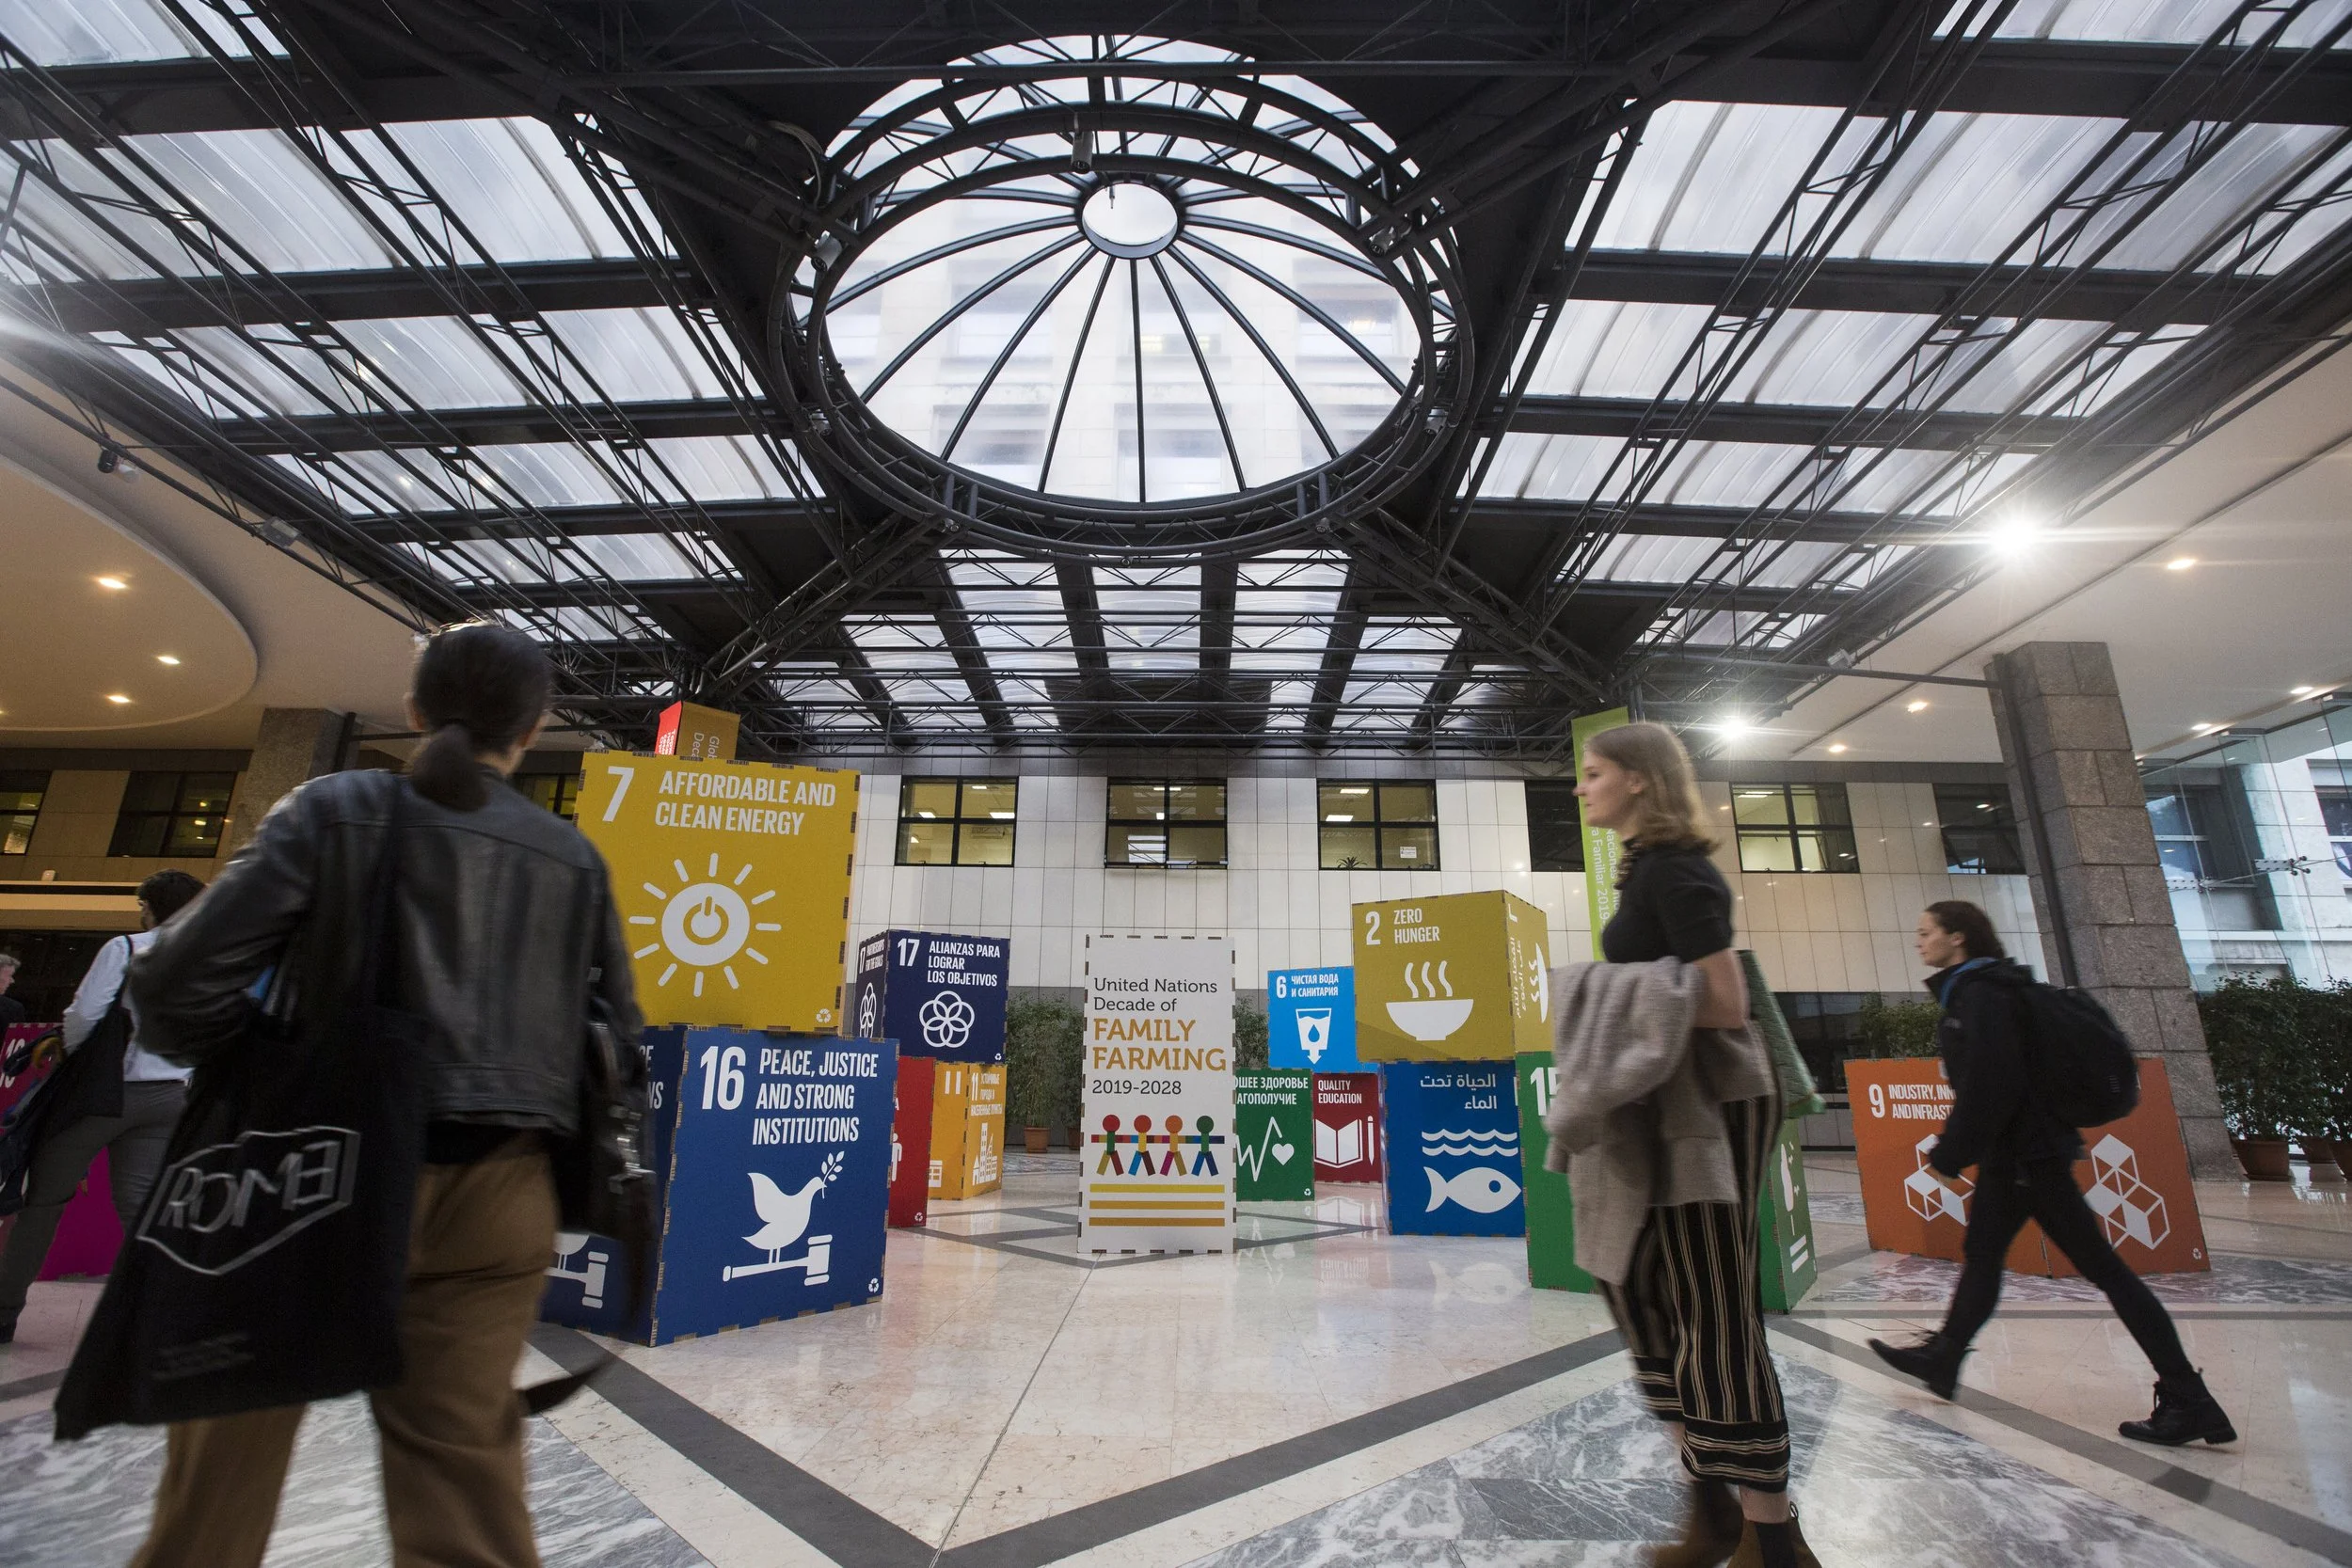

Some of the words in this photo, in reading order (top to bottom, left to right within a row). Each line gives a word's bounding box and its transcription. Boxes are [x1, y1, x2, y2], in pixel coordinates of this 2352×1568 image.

[602, 766, 634, 822] 7
[659, 770, 790, 804] AFFORDABLE
[793, 782, 836, 807] AND
[655, 801, 723, 830] CLEAN
[725, 807, 805, 835] ENERGY
[1592, 838, 1605, 885] Familiar
[1393, 908, 1422, 926] ZERO
[1597, 889, 1611, 929] 2019-
[1365, 911, 1381, 946] 2
[1394, 926, 1440, 944] HUNGER
[897, 938, 920, 967] 17
[929, 941, 975, 957] ALIANZAS
[976, 944, 1000, 958] PARA
[928, 956, 965, 970] LOGRAR
[927, 971, 946, 984] LOS
[947, 972, 997, 987] OBJETIVOS
[1093, 977, 1149, 992] United
[1154, 978, 1217, 993] Nations
[1276, 975, 1287, 998] 6
[1291, 975, 1317, 985] ЧИСТАЯ
[1319, 974, 1339, 985] ВОДА
[1291, 989, 1296, 997] И
[1298, 987, 1339, 997] САНИТАРИЯ
[1093, 996, 1155, 1011] Decade
[1160, 998, 1178, 1011] of
[1093, 1018, 1197, 1041] FAMILY
[759, 1048, 816, 1077] PEACE,
[818, 1051, 879, 1077] JUSTICE
[1092, 1046, 1227, 1071] FARMING
[700, 1045, 747, 1111] 16
[1092, 1079, 1182, 1095] 2019-2028
[1234, 1076, 1258, 1088] ОШЕЕ
[1261, 1077, 1309, 1090] ЗДОРОВЬЕ
[1318, 1080, 1351, 1091] QUALITY
[1420, 1074, 1452, 1088] تحت
[1456, 1073, 1496, 1091] الحياة
[755, 1083, 791, 1110] AND
[793, 1084, 855, 1110] STRONG
[1235, 1093, 1297, 1105] АГОПОЛУЧИЕ
[1318, 1093, 1362, 1104] EDUCATION
[1868, 1084, 1885, 1118] 9
[1888, 1084, 1937, 1101] INDUSTRY,
[1936, 1085, 1957, 1100] INN
[1464, 1095, 1498, 1110] الماء
[1892, 1103, 1912, 1119] AND
[752, 1117, 860, 1145] INSTITUTIONS
